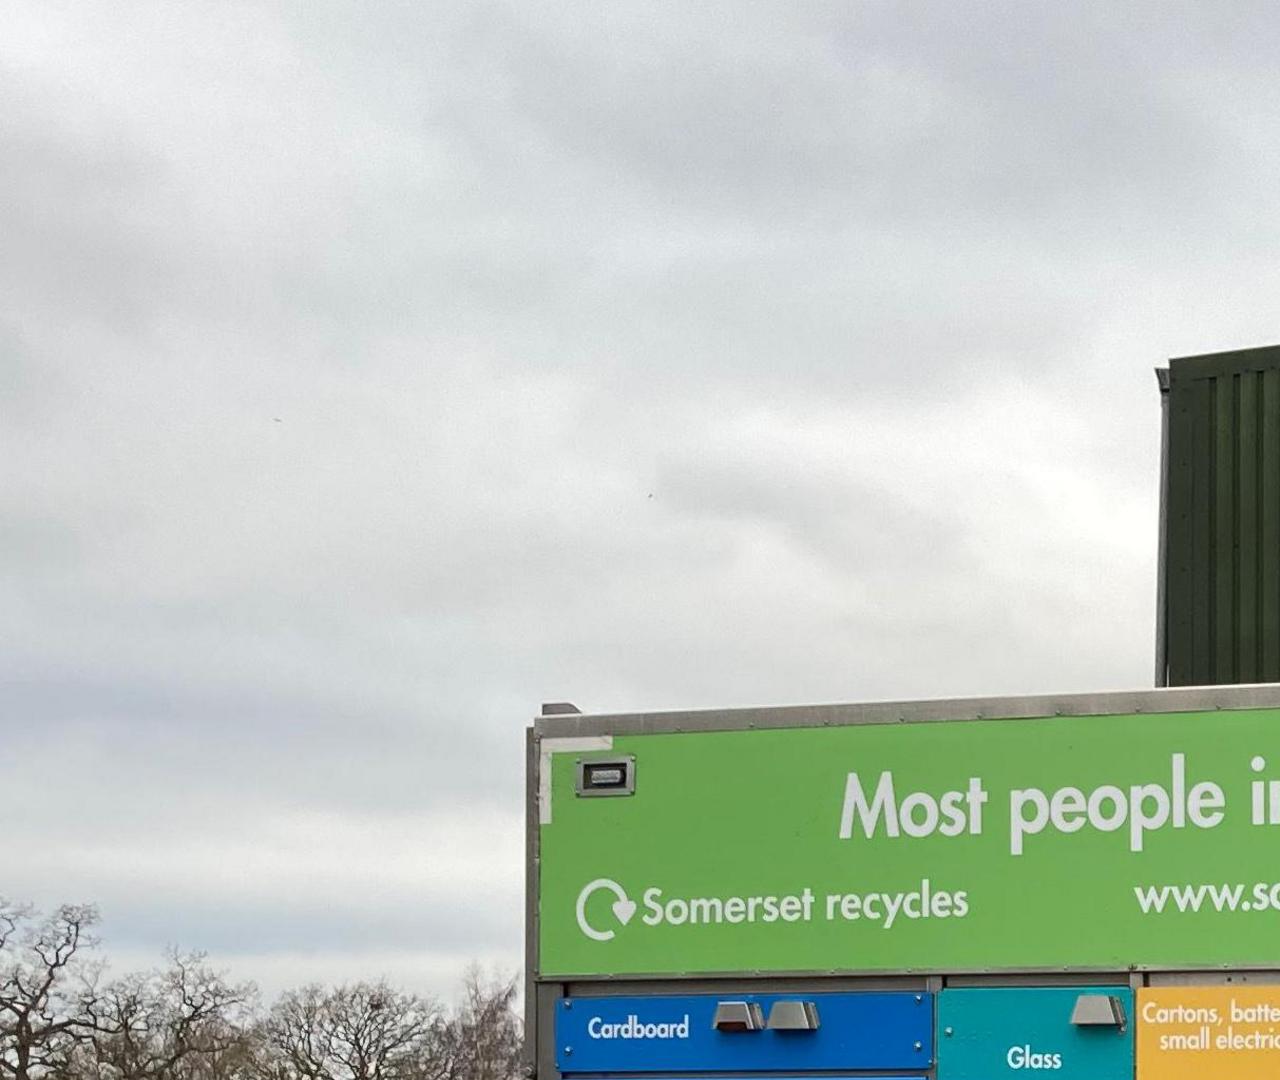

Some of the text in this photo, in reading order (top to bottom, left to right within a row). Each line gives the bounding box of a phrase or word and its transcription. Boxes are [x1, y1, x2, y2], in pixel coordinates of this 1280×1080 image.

[840, 771, 988, 839] Most
[1010, 752, 1226, 856] people
[642, 878, 969, 929] Somerset recycles
[1142, 1001, 1223, 1026] Cartons,
[588, 1014, 689, 1040] Cardboard
[1160, 1026, 1210, 1050] small
[1007, 1044, 1062, 1070] Glass
